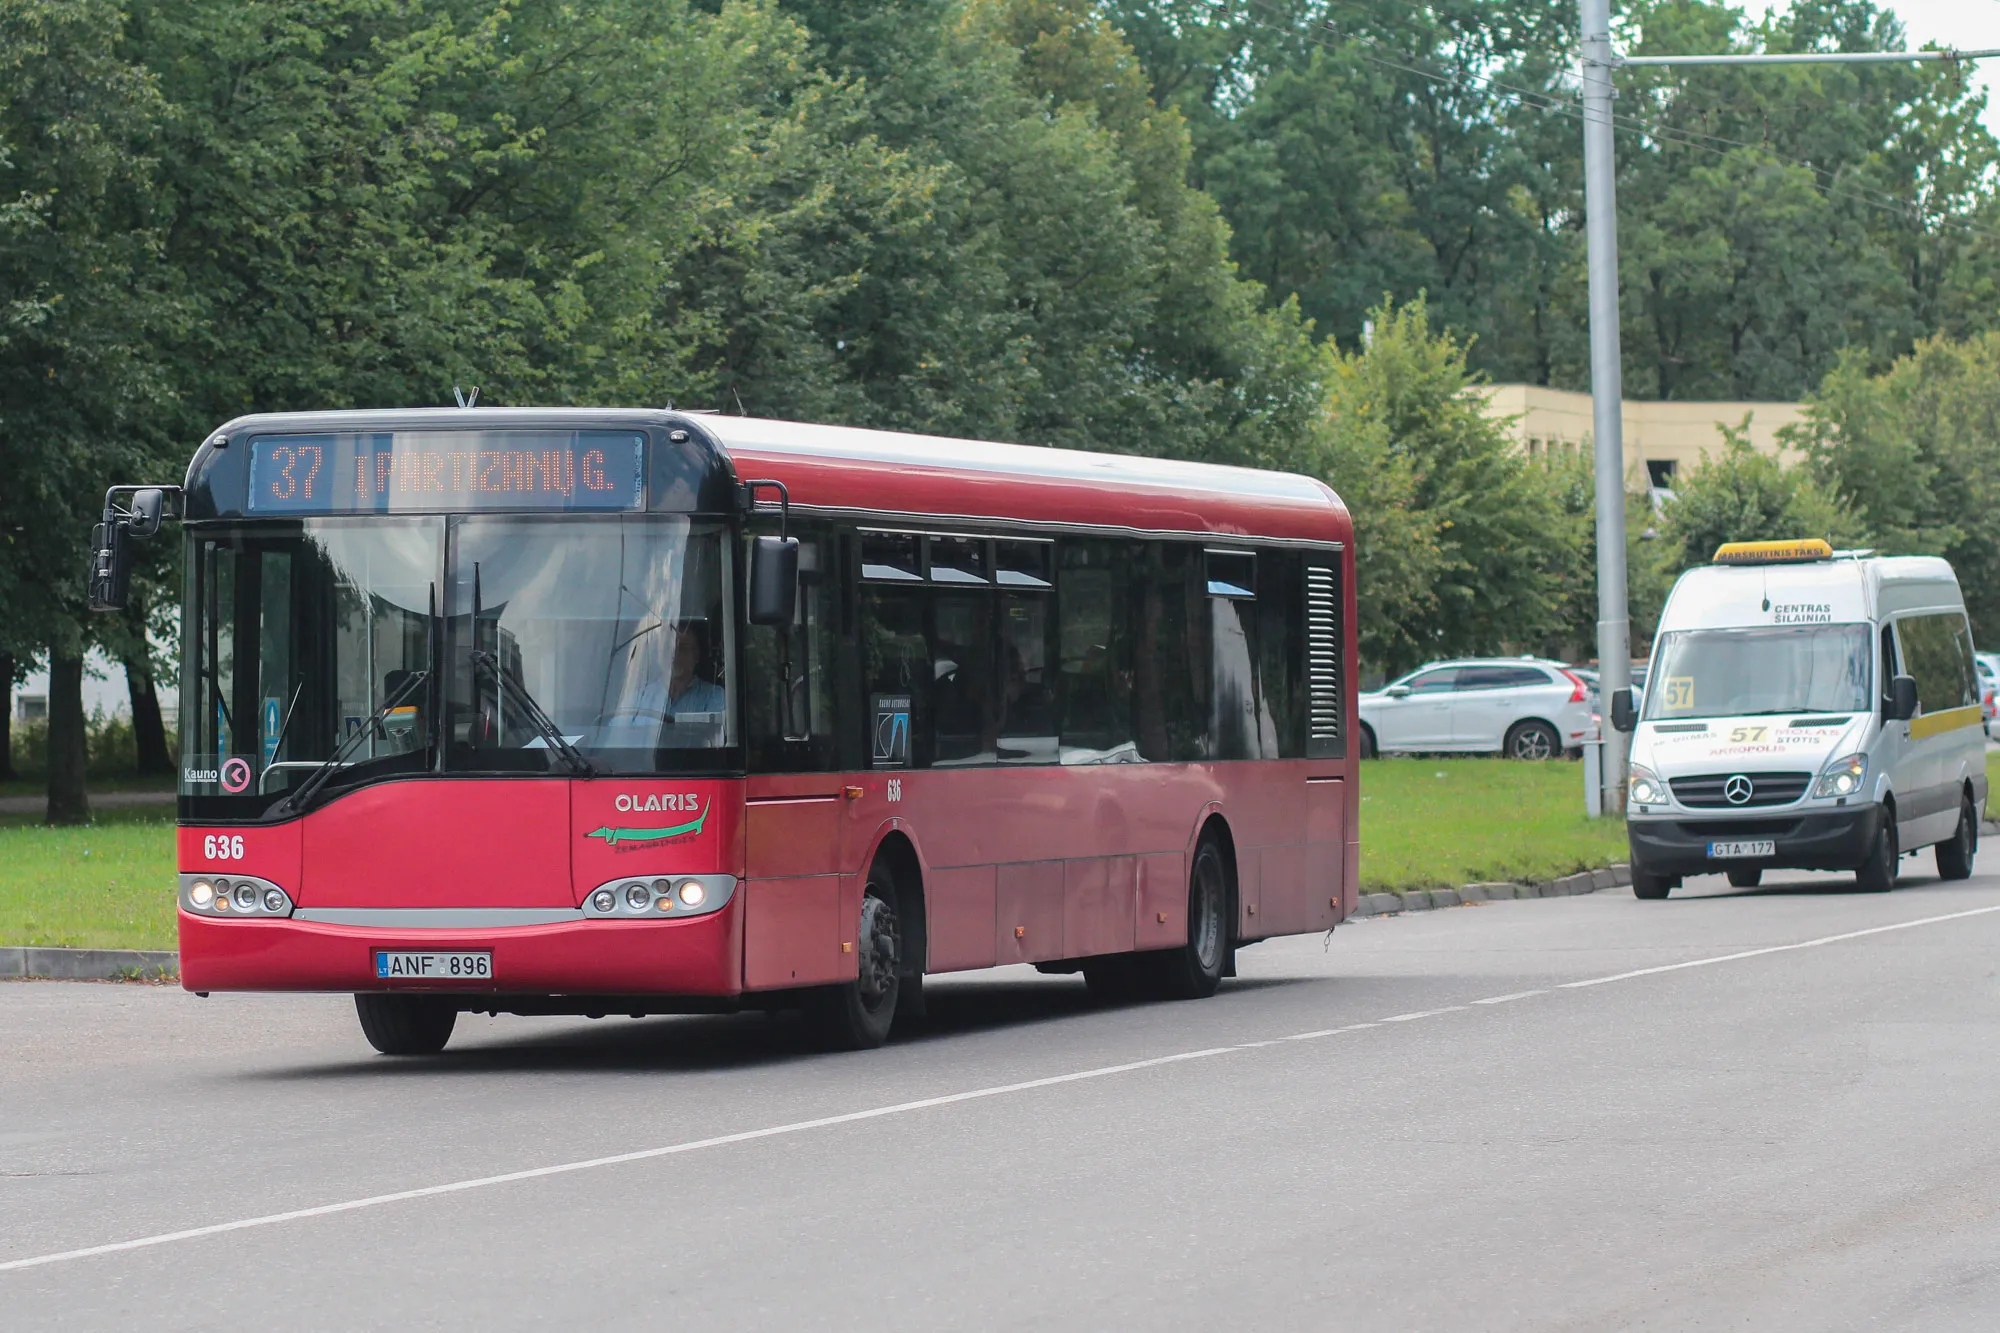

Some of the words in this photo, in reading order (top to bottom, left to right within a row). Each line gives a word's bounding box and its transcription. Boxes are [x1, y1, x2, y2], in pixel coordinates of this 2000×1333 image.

[272, 446, 323, 499] 37
[376, 450, 574, 497] PARTIZANŲ
[583, 450, 615, 490] G.
[1774, 604, 1831, 613] CENTRAS
[1666, 681, 1692, 706] 57
[1731, 726, 1768, 742] 57
[1776, 735, 1821, 744] STOTIS
[1708, 745, 1786, 757] AKROPOLIS
[184, 768, 218, 779] Kauno
[887, 779, 901, 802] 636
[615, 793, 699, 812] OLARIS
[204, 835, 244, 860] 636
[1715, 843, 1742, 855] GTA
[1751, 842, 1773, 854] 177
[391, 956, 434, 975] ANF
[449, 956, 488, 975] 896
